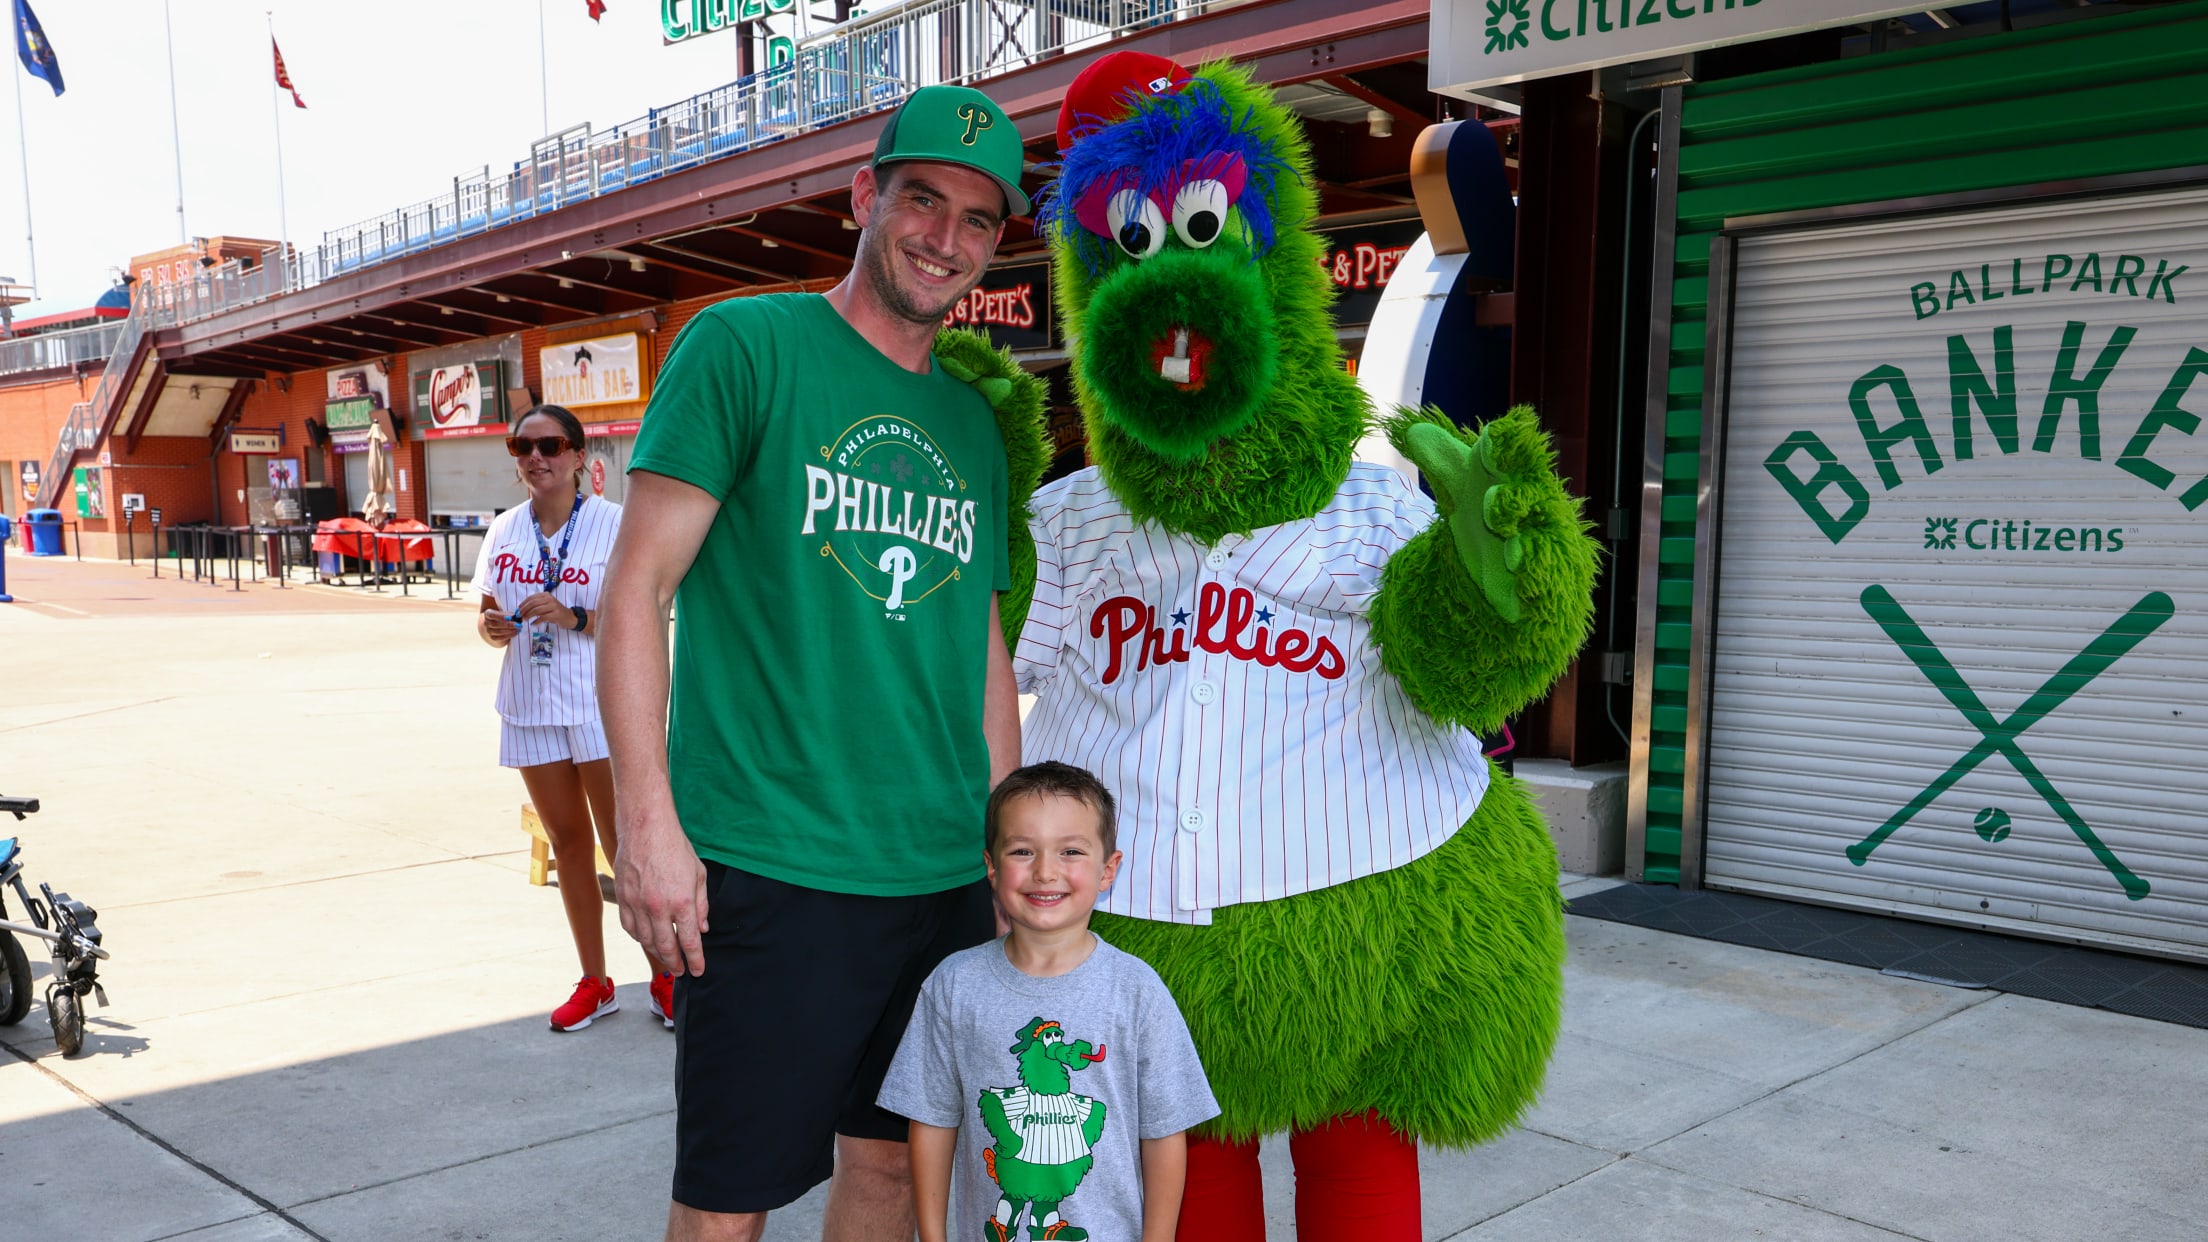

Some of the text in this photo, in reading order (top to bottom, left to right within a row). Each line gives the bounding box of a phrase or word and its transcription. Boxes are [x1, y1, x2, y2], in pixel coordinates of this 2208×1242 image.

[958, 103, 993, 146] P
[970, 284, 1034, 327] PETE'S
[1910, 253, 2189, 320] BALLPARK
[336, 377, 358, 397] PIZZA
[603, 367, 628, 400] BAR
[838, 424, 955, 491] PHILADELPHIA
[1763, 320, 2208, 545] BANKE
[801, 463, 976, 564] PHILLIES
[1964, 519, 2124, 553] Citizens
[878, 545, 917, 610] P
[1090, 581, 1347, 686] Phillies
